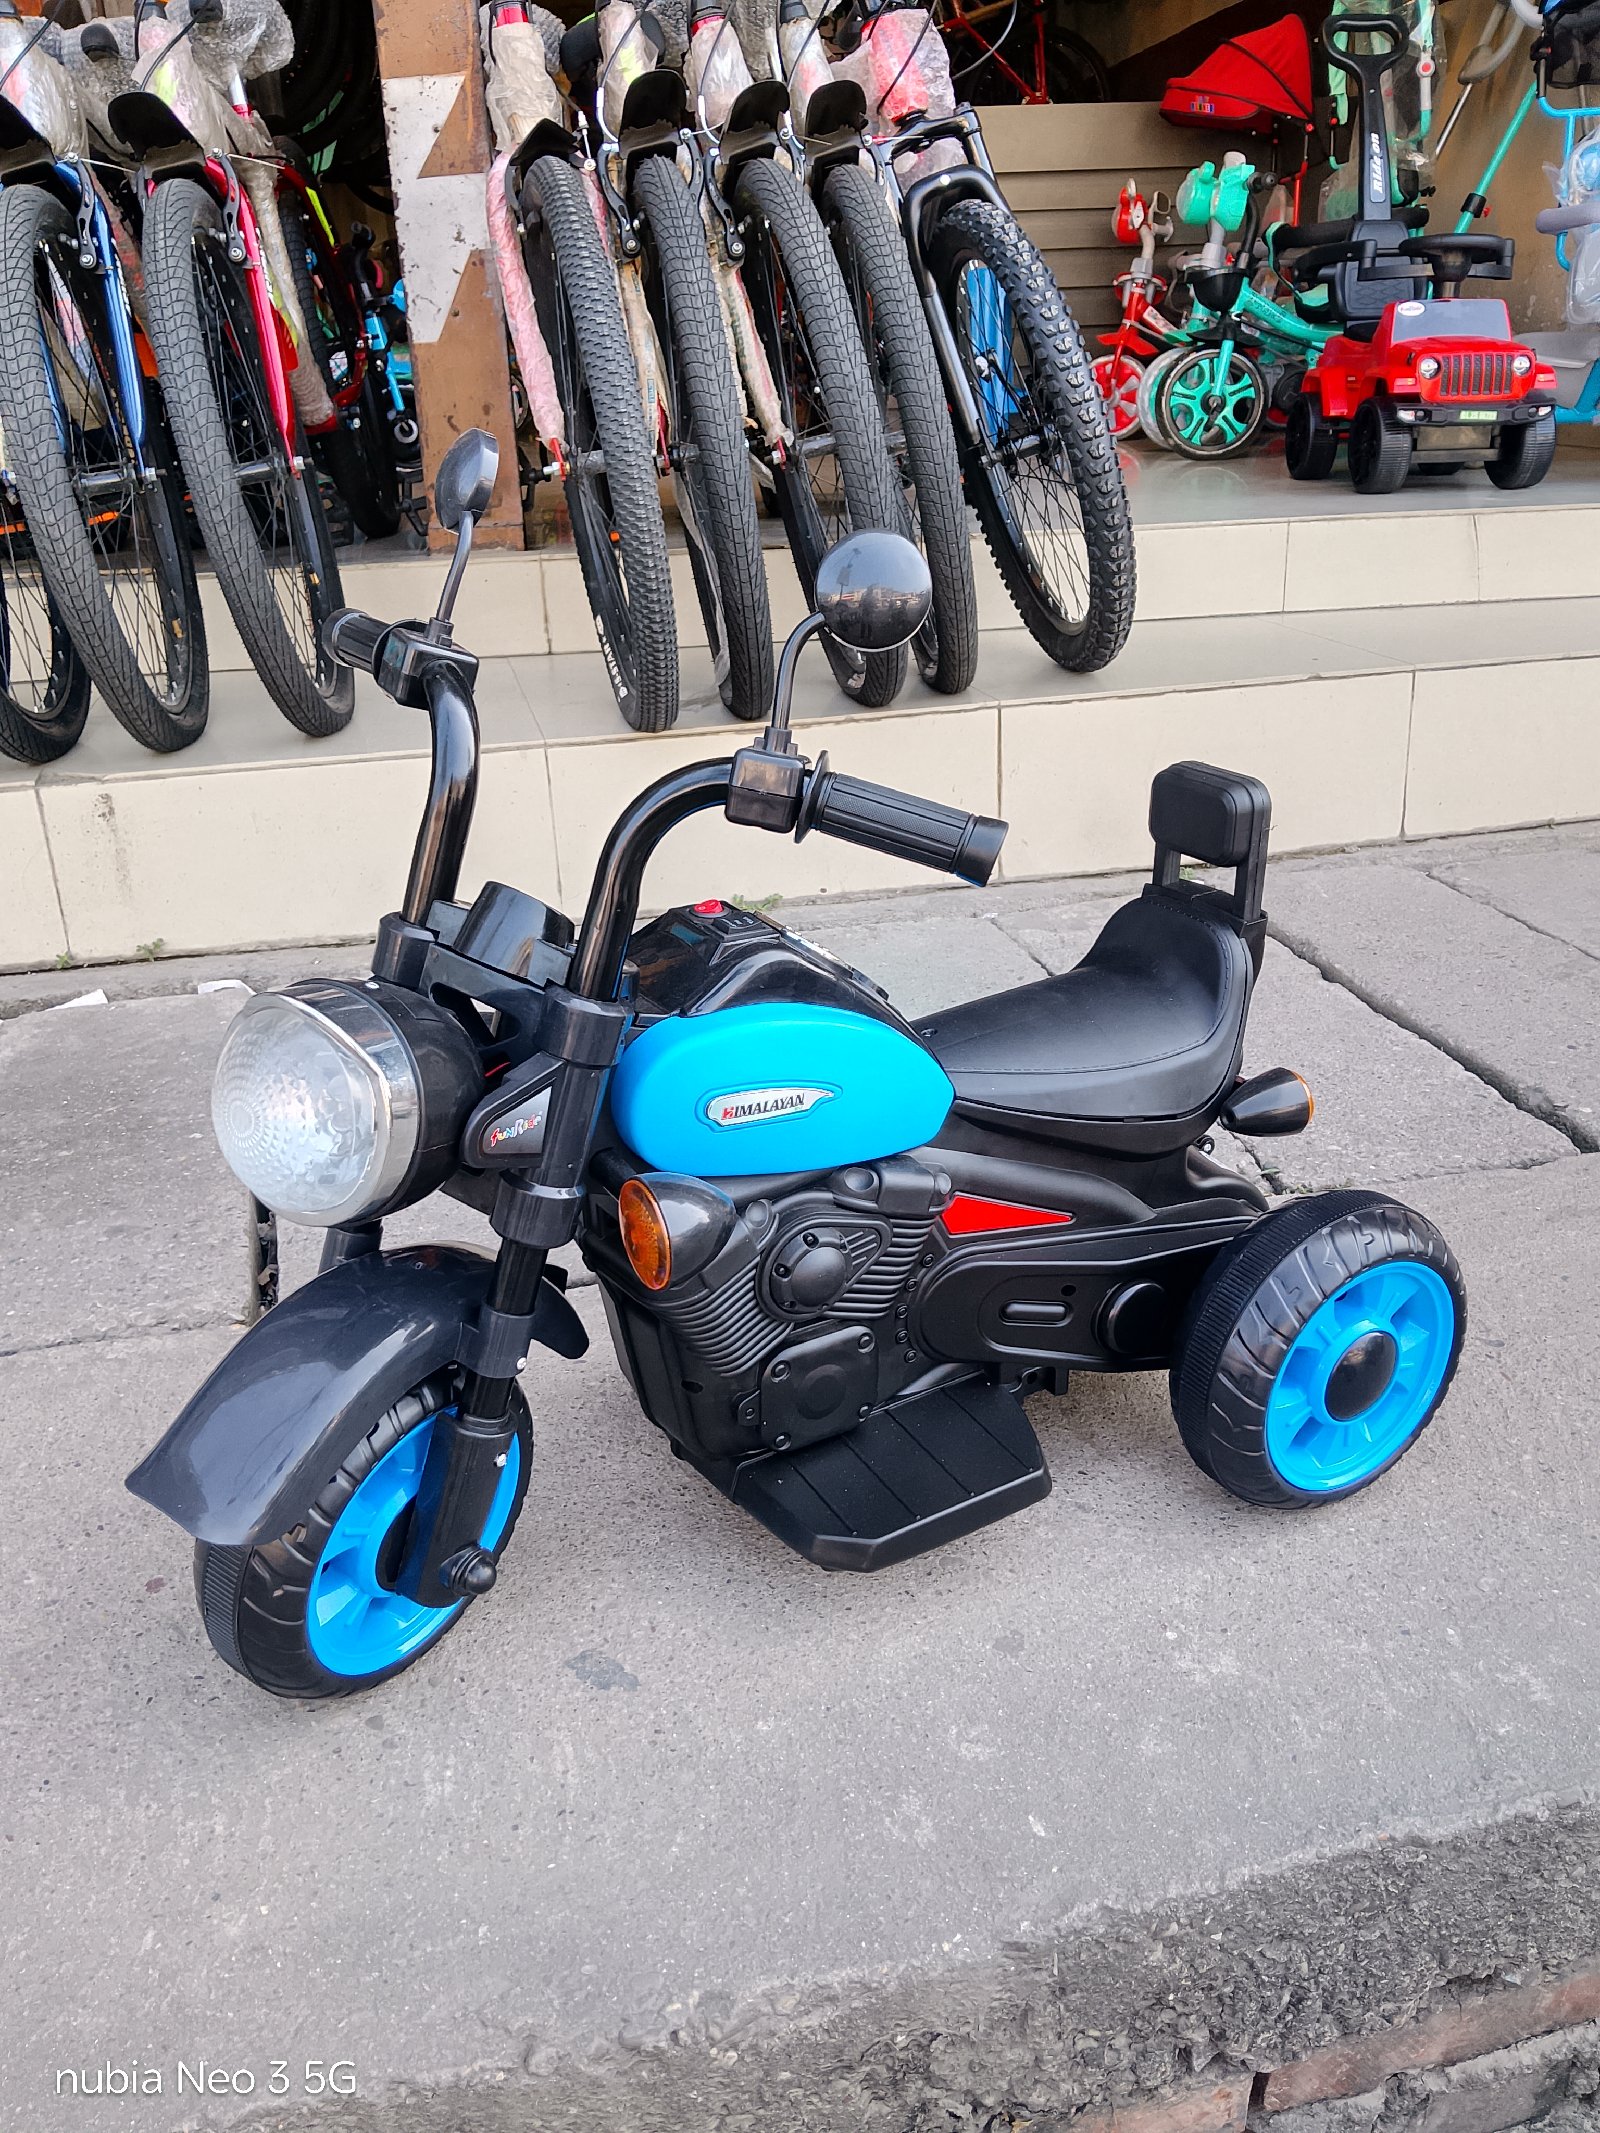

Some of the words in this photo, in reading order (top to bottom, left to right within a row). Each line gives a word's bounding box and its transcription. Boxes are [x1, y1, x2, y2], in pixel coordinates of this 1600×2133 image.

[1370, 132, 1380, 154] on
[1372, 155, 1384, 194] Ride
[721, 1093, 805, 1120] HIMALAYAN
